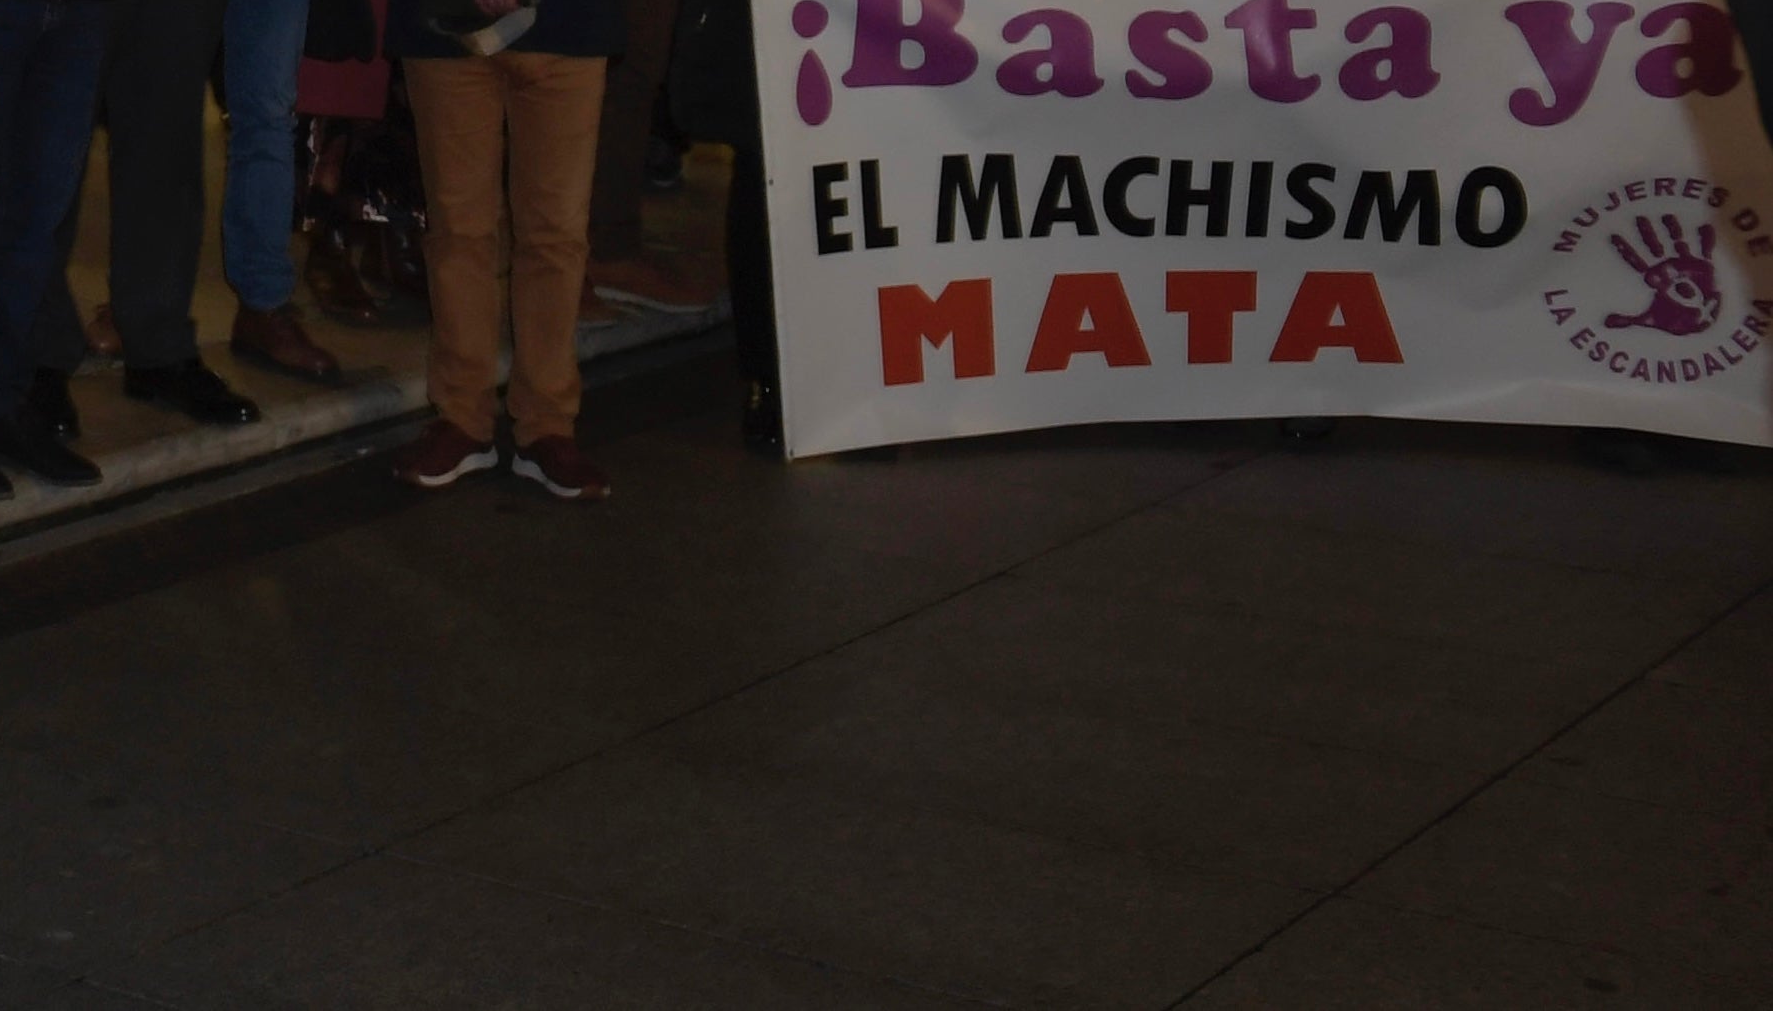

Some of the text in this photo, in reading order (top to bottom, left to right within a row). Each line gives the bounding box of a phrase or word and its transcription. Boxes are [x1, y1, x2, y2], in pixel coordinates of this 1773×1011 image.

[812, 153, 1528, 256] EL MACHISMO
[1552, 177, 1773, 257] MUJERES DE
[878, 271, 1405, 386] MATA
[1543, 289, 1773, 383] LA ESCANDALERA
